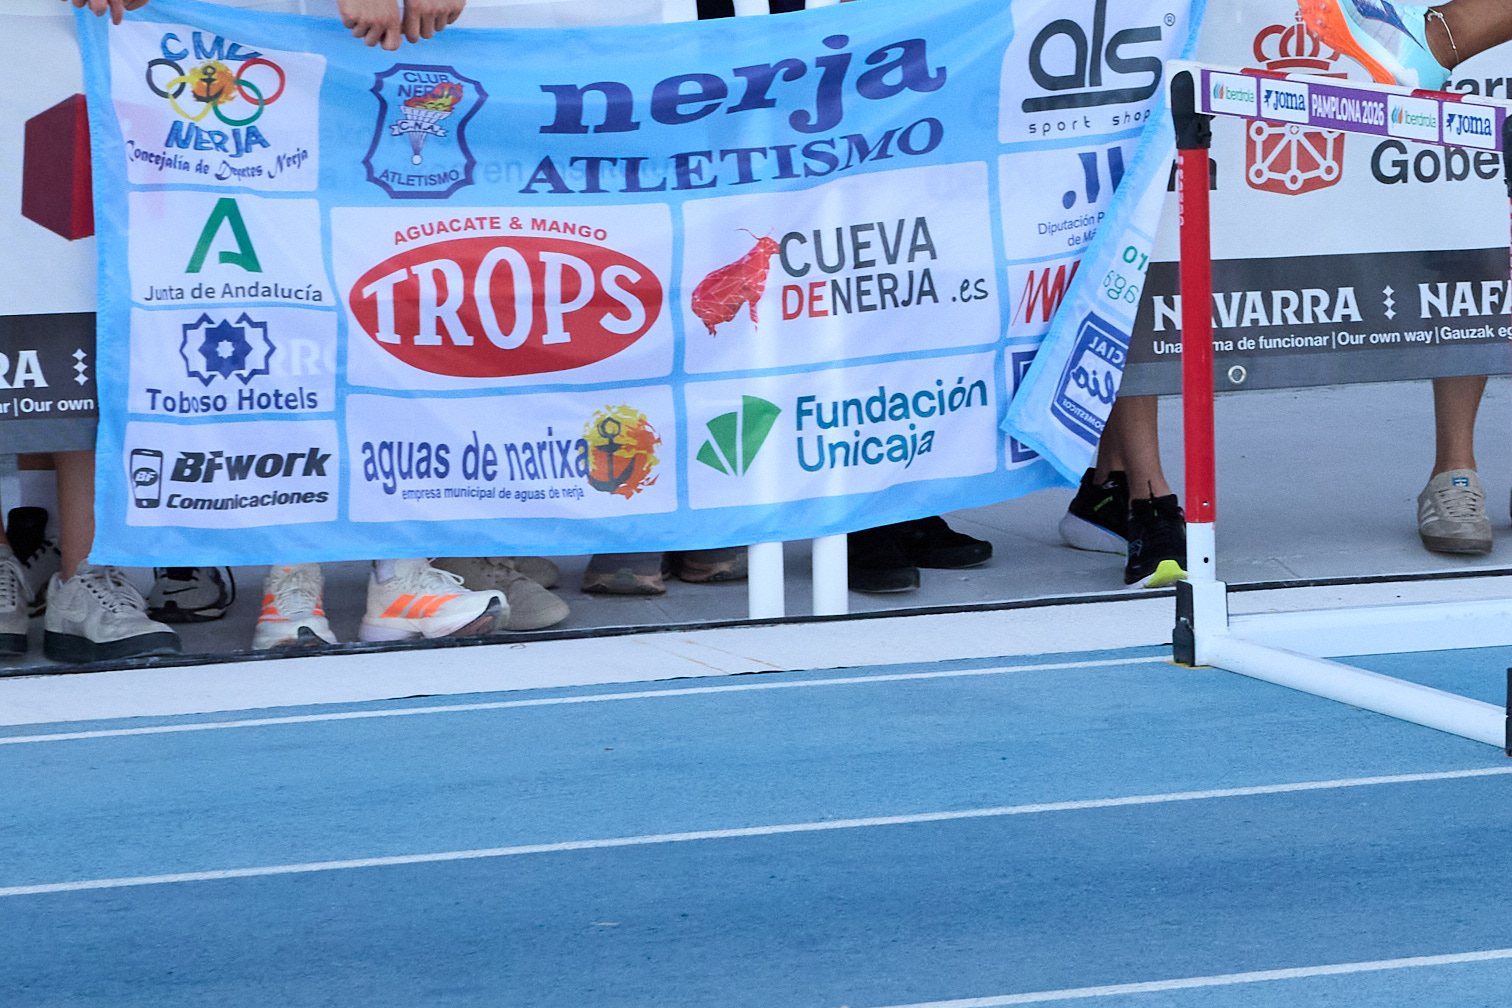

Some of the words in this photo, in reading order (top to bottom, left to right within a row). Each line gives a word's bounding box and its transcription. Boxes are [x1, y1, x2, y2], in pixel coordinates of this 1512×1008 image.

[403, 72, 449, 84] CLUB
[539, 34, 947, 134] nerja
[1225, 86, 1255, 103] Iberdrola
[1272, 90, 1306, 112] Joma
[1028, 116, 1091, 136] sport
[1112, 109, 1151, 127] shop
[1311, 93, 1361, 123] PAMPLONA
[1361, 101, 1385, 126] 2026
[1403, 110, 1437, 128] Iberdrola
[164, 120, 271, 158] NERJA
[1455, 113, 1493, 137] Joma
[195, 159, 210, 174] de
[268, 148, 308, 179] Nerja
[518, 117, 945, 194] ATLETISMO
[380, 168, 460, 187] ATLETISMO
[394, 216, 501, 245] AGUACATE
[508, 216, 523, 229] &
[531, 217, 608, 241] MANGO
[1037, 214, 1095, 236] Diputación
[779, 216, 938, 278] CUEVA
[1067, 235, 1081, 246] de
[144, 285, 184, 302] Junta
[191, 282, 215, 300] de
[221, 281, 323, 302] Andalucía
[362, 246, 646, 351] TROPS
[781, 268, 940, 321] DENERJA
[951, 278, 989, 303] .es
[1152, 287, 1363, 331] NVARRA
[1153, 340, 1182, 354] Una
[1237, 336, 1256, 350] de
[1369, 330, 1401, 344] own
[56, 396, 95, 411] own
[146, 388, 227, 414] Toboso
[238, 386, 318, 411] Hotels
[796, 376, 988, 431] Fundación
[362, 439, 450, 495] aguas
[462, 430, 498, 481] de
[504, 426, 591, 481] narixa
[796, 423, 936, 472] Unicaja
[170, 447, 332, 484] BFwork
[166, 490, 330, 511] Comunicaciones
[402, 486, 441, 502] empresa
[444, 485, 496, 500] municipal
[499, 487, 512, 499] de
[514, 489, 546, 502] aguas
[549, 486, 561, 499] de
[562, 485, 585, 500] nerja
